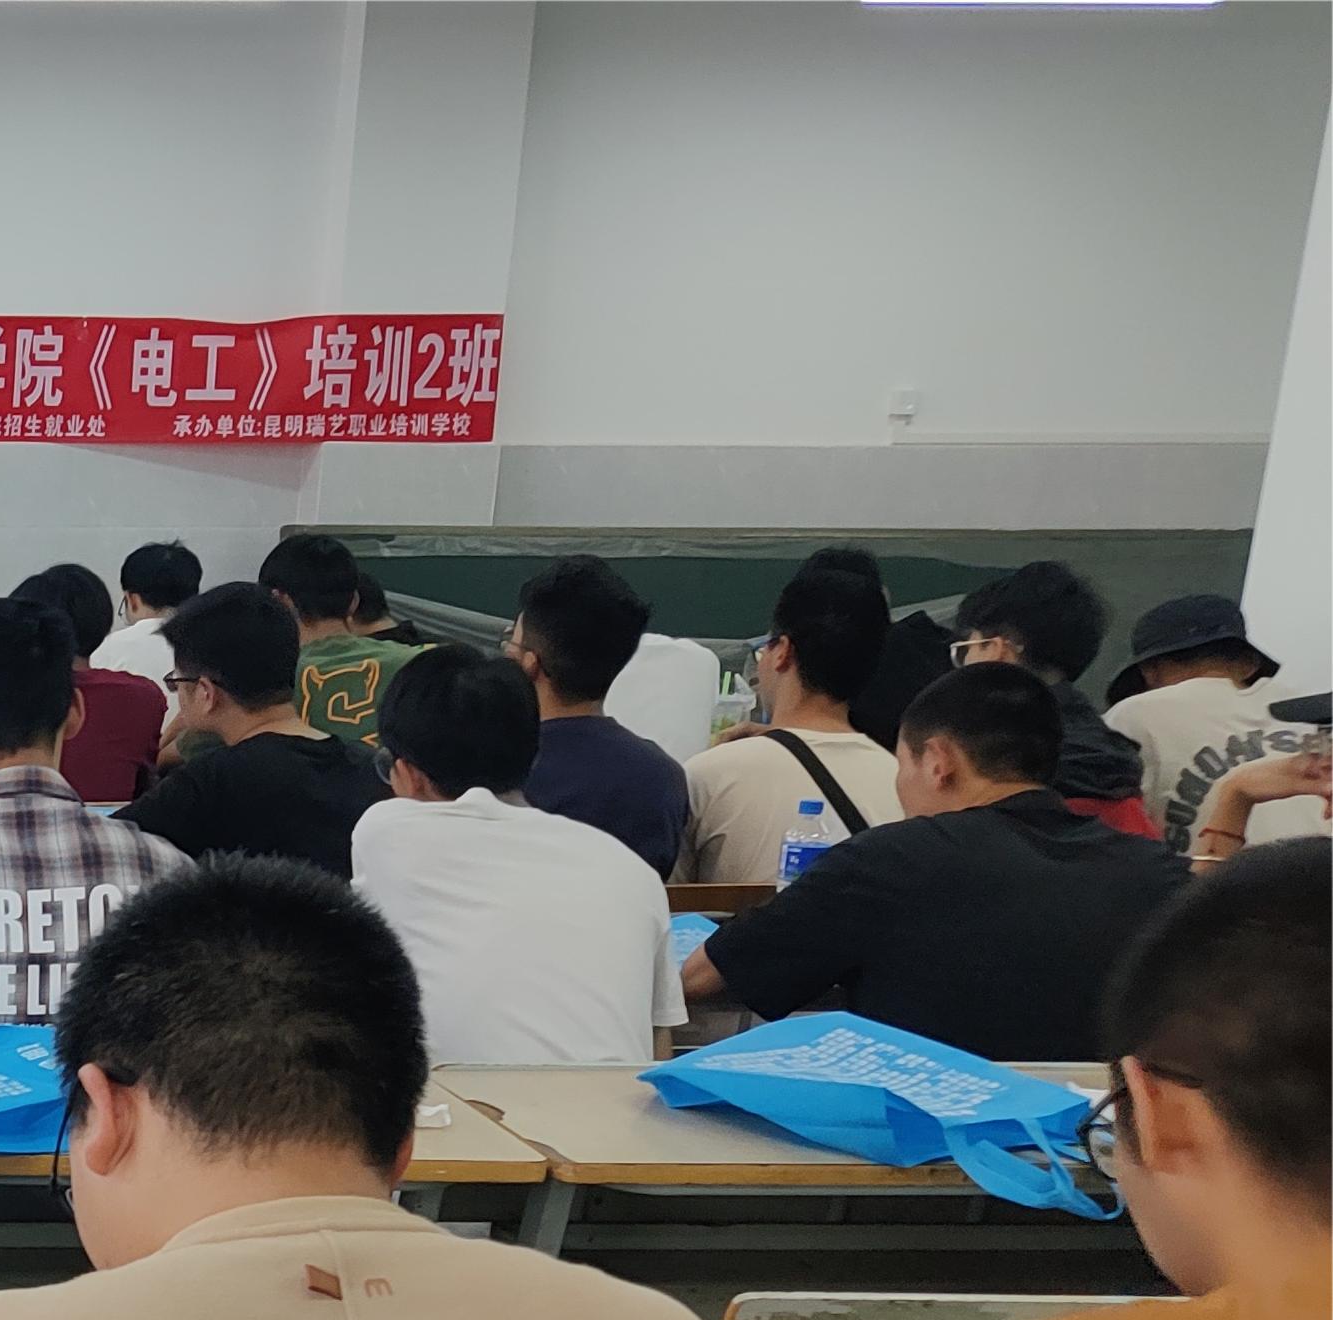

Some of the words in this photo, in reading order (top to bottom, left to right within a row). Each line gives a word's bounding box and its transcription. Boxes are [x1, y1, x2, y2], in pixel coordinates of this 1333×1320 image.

[172, 413, 472, 438] 承办单位:昆明瑞艺职业培训学校
